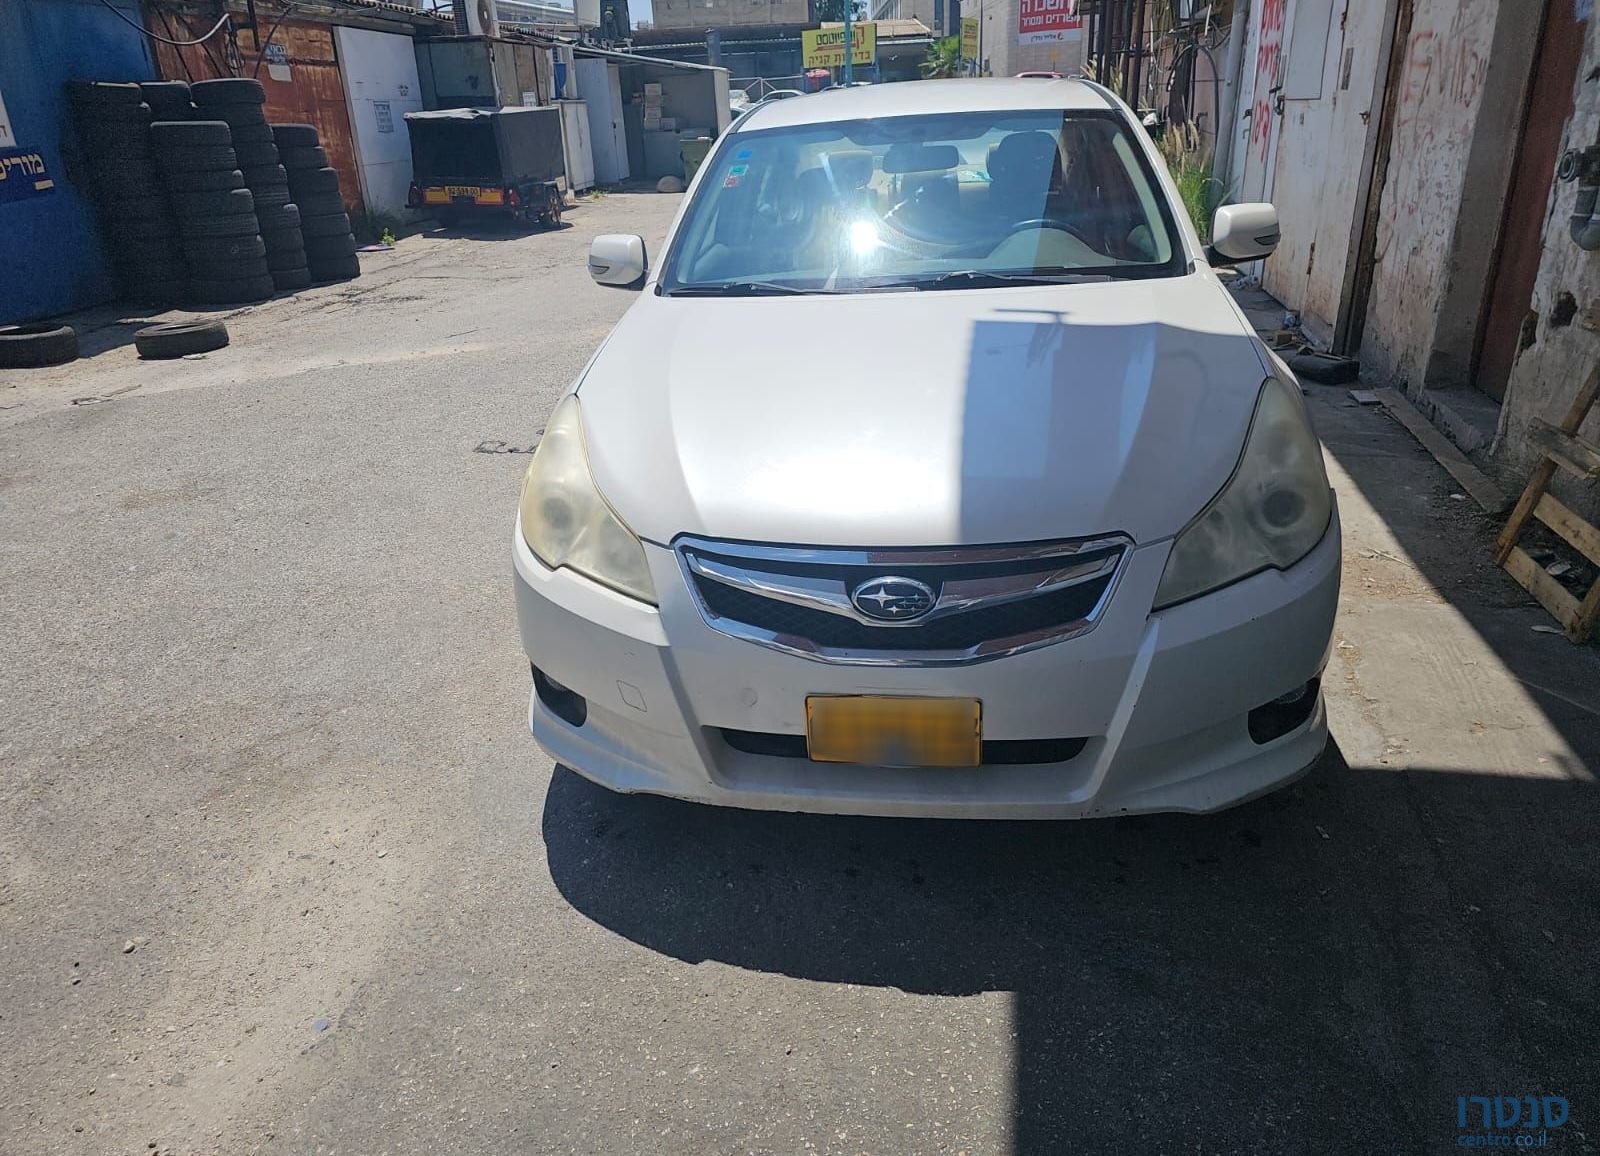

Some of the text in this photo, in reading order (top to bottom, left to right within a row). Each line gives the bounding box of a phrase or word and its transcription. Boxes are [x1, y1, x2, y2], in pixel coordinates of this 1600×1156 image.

[816, 25, 865, 49] קופיוטסט
[808, 51, 871, 67] בדיות קניה
